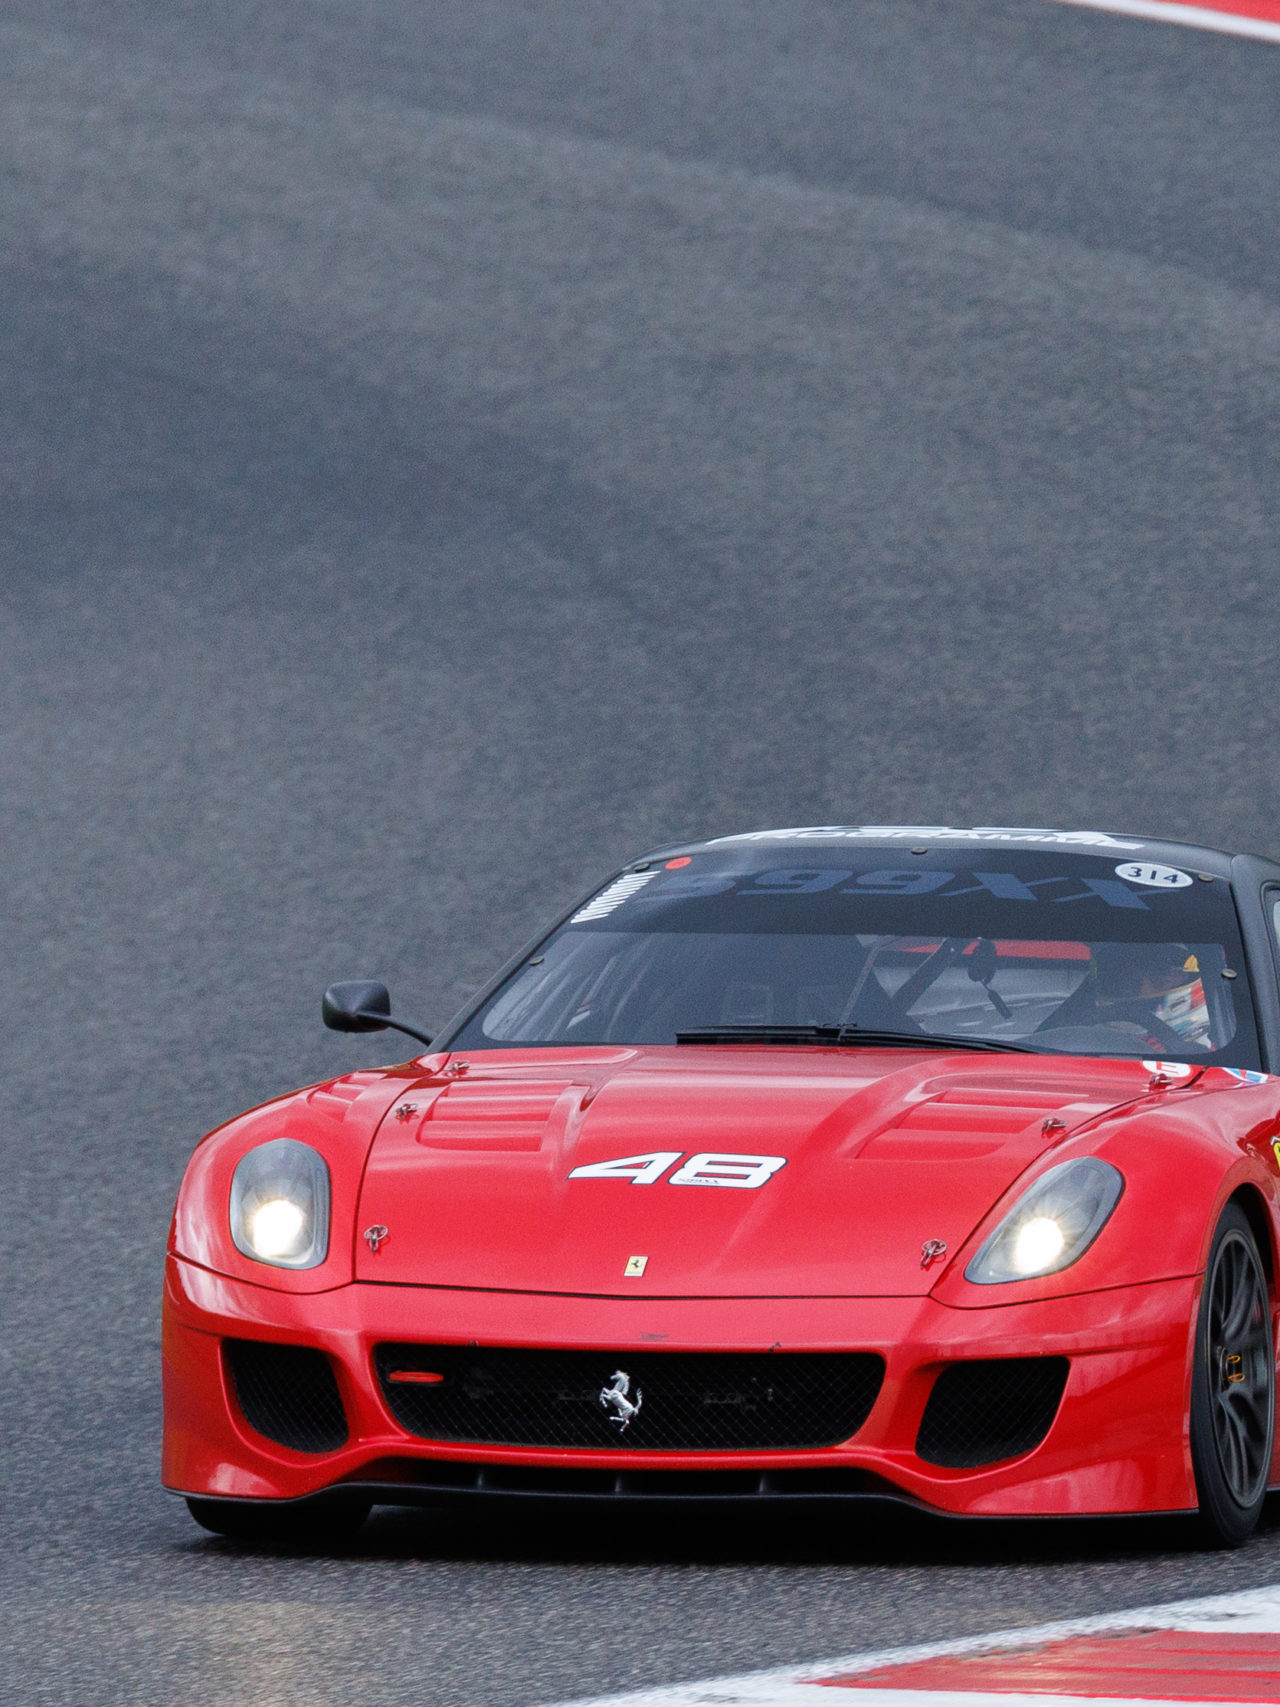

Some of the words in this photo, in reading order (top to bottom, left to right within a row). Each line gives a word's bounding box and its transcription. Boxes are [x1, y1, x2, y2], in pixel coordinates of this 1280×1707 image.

[634, 869, 1181, 911] 599XX
[1126, 866, 1179, 884] 314
[566, 1151, 788, 1190] 48
